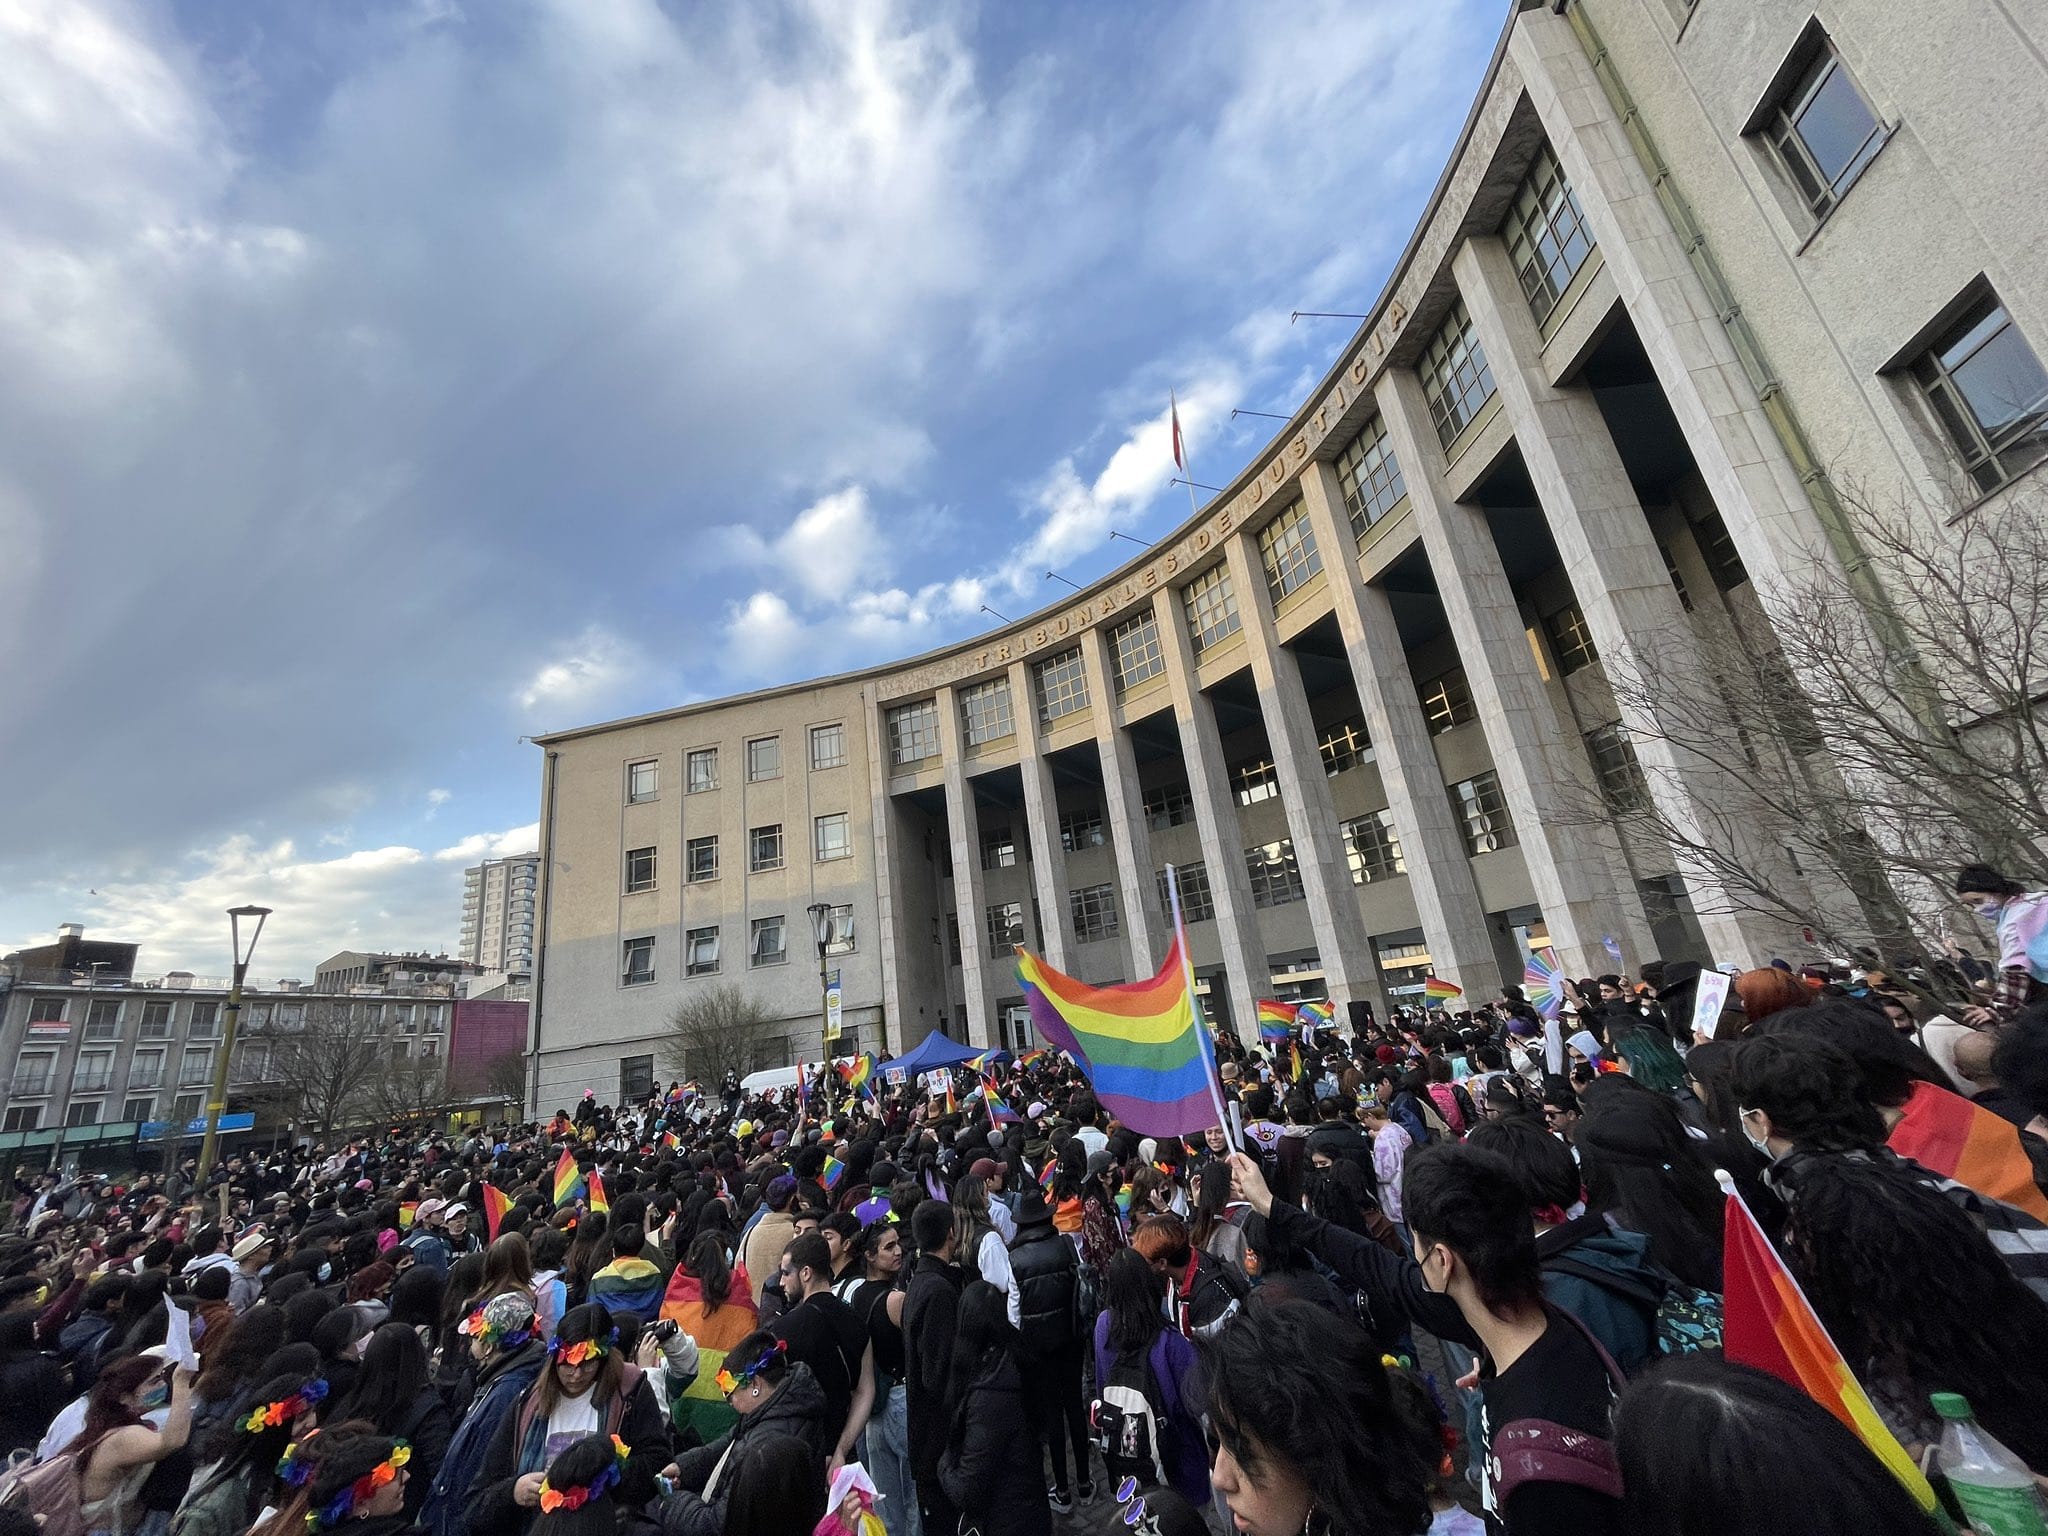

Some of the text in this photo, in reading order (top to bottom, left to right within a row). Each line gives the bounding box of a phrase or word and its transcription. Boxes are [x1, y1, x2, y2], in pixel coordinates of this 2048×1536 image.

[974, 299, 1408, 669] TRIBUNALES DE JUSTICIA
